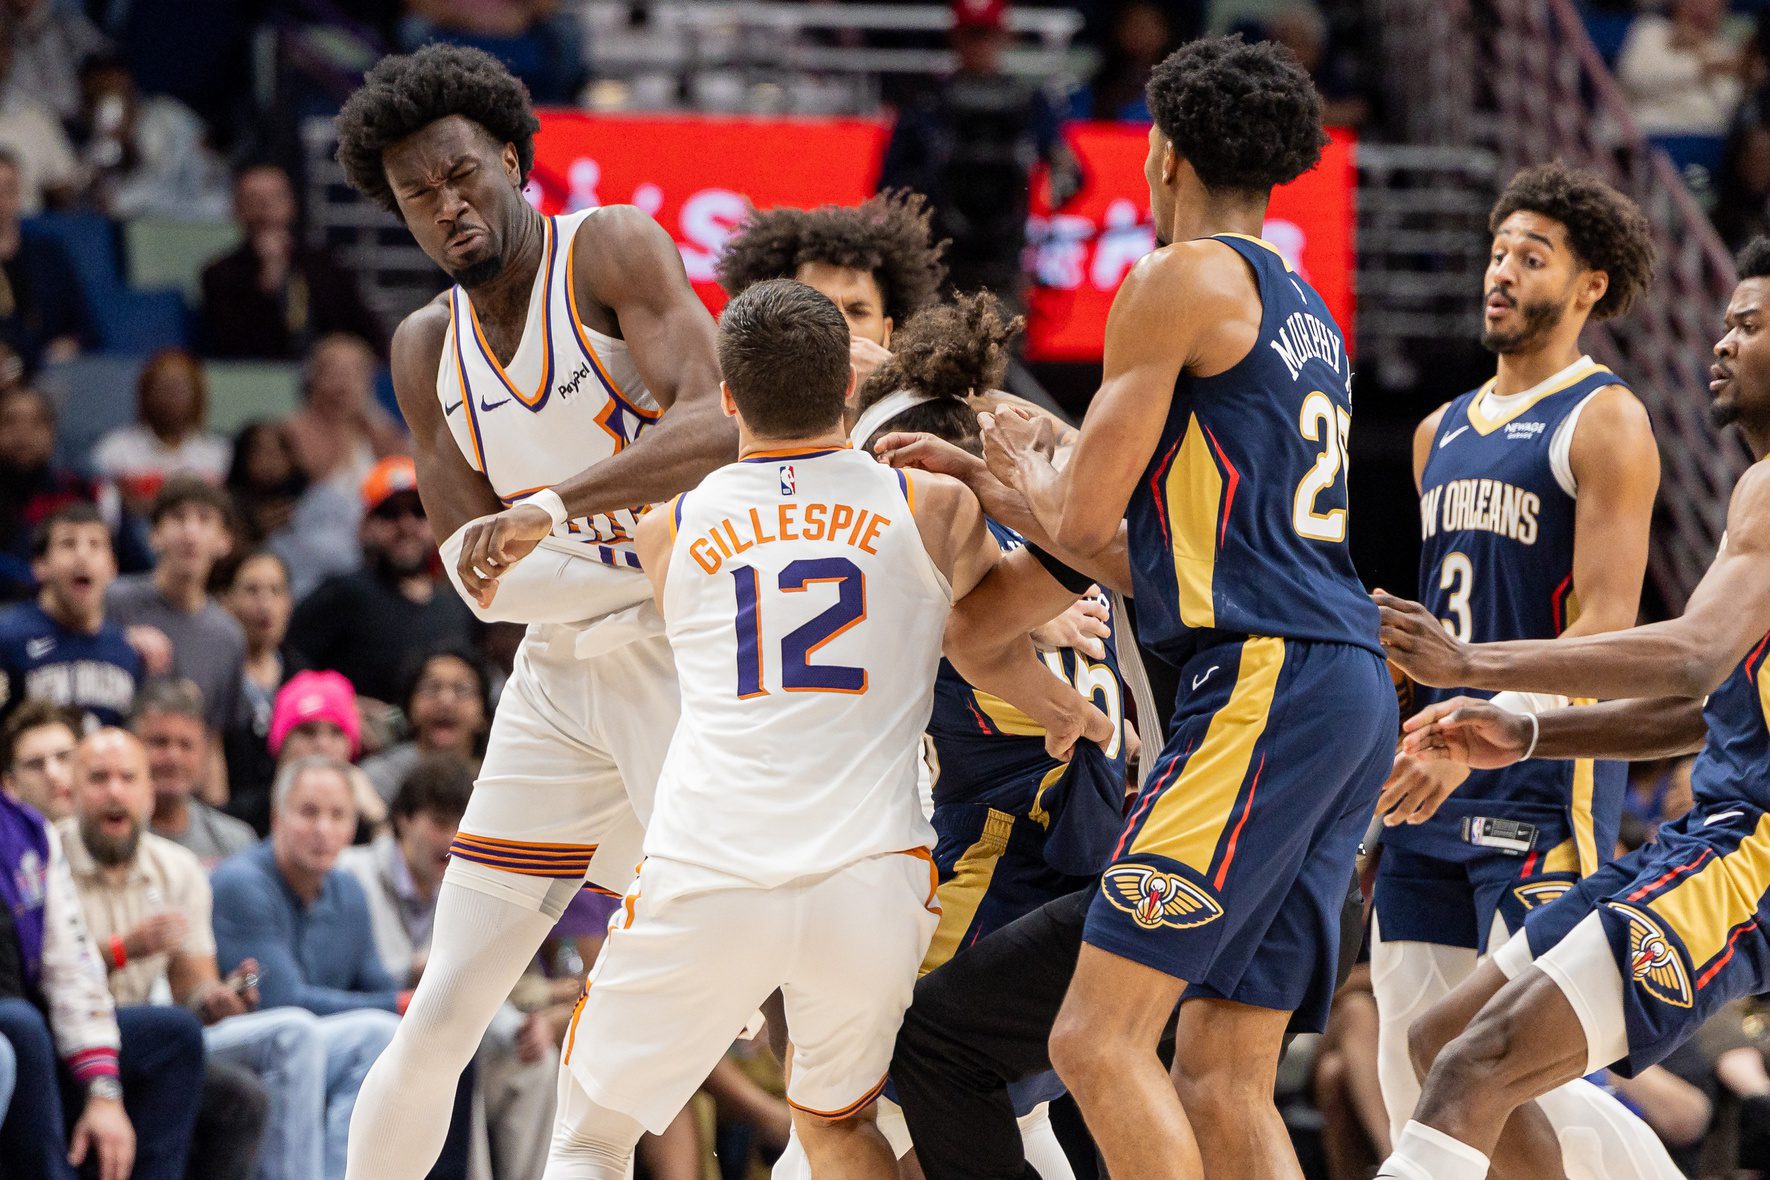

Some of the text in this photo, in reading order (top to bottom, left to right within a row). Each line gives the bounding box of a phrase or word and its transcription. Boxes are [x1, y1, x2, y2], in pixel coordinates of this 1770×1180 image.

[558, 361, 590, 400] PayPal
[1270, 312, 1341, 382] MURPHY
[689, 503, 892, 576] GILLESPIE
[1442, 478, 1541, 546] ORLEANS
[729, 556, 870, 701] 12
[1439, 551, 1473, 645] 3
